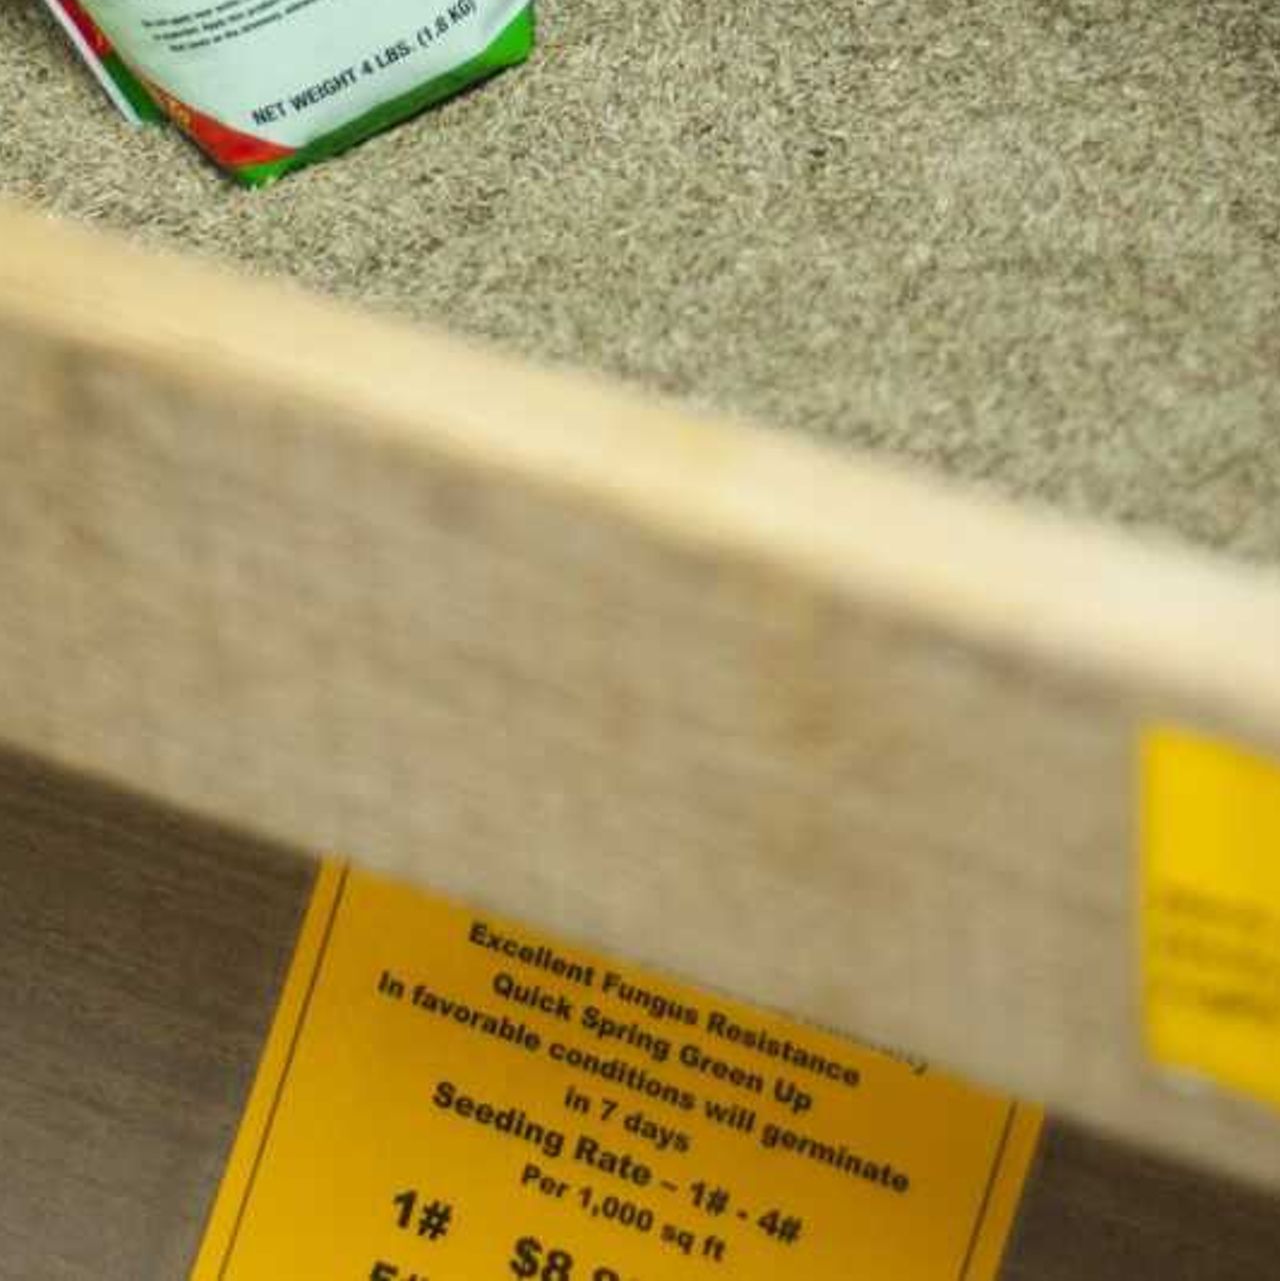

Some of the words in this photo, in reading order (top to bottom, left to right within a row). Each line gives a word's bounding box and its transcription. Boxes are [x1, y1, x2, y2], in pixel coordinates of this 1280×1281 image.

[251, 101, 288, 128] NET
[289, 66, 360, 114] WEIGHT
[360, 58, 376, 76] 4
[468, 921, 596, 988] Excellent
[601, 972, 700, 1026] Fungus
[707, 1010, 862, 1088] Resistance
[492, 972, 574, 1022] Quick
[580, 1005, 672, 1063] Spring
[678, 1043, 764, 1094] Green
[773, 1076, 814, 1115] Up
[377, 970, 406, 1000] In
[412, 984, 542, 1053] favorable
[548, 1040, 697, 1112] conditions
[704, 1098, 757, 1134] will
[760, 1121, 910, 1193] germinate
[564, 1086, 592, 1114] in
[600, 1099, 619, 1121] 7
[623, 1111, 693, 1154] days
[392, 1188, 454, 1241] 1#
[431, 1079, 566, 1158] Seeding
[574, 1134, 654, 1188] Rate
[689, 1180, 730, 1216] 1#
[756, 1208, 803, 1245] 4#
[521, 1163, 570, 1200] Per
[577, 1185, 655, 1233] 1,000
[660, 1223, 696, 1256] sq
[702, 1235, 726, 1263] ft
